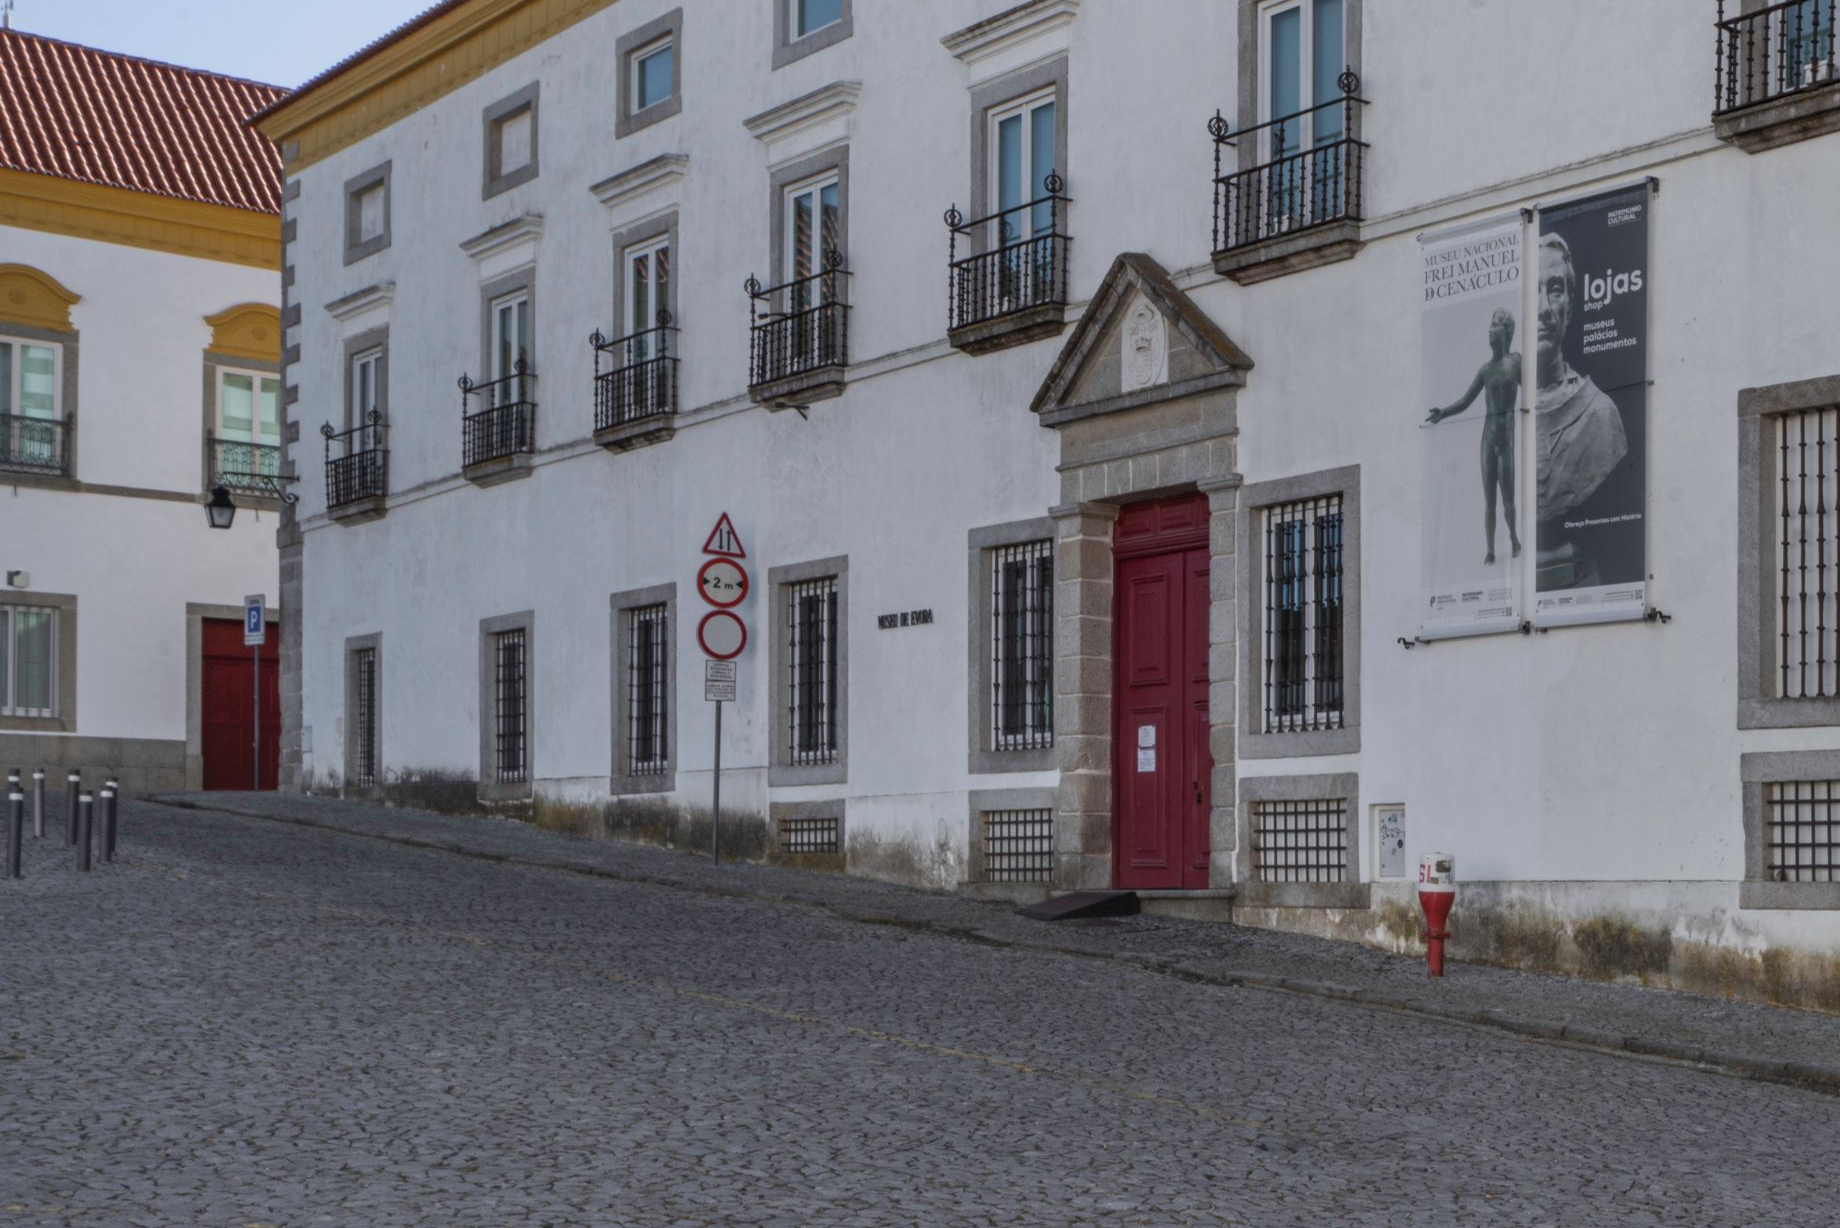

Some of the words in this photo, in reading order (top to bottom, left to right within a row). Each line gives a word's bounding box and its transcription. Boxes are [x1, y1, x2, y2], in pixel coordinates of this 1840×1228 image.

[1425, 250, 1459, 267] MUSEU
[1464, 234, 1519, 258] NACIONAL
[1425, 264, 1454, 284] FREI
[1458, 249, 1519, 276] MANUEL
[1584, 269, 1643, 305] lojas
[1584, 300, 1604, 311] shop
[1584, 318, 1615, 332] museus
[1584, 329, 1618, 345] palácios
[1584, 337, 1637, 354] monumentos
[713, 577, 721, 589] 2
[250, 610, 258, 629] P
